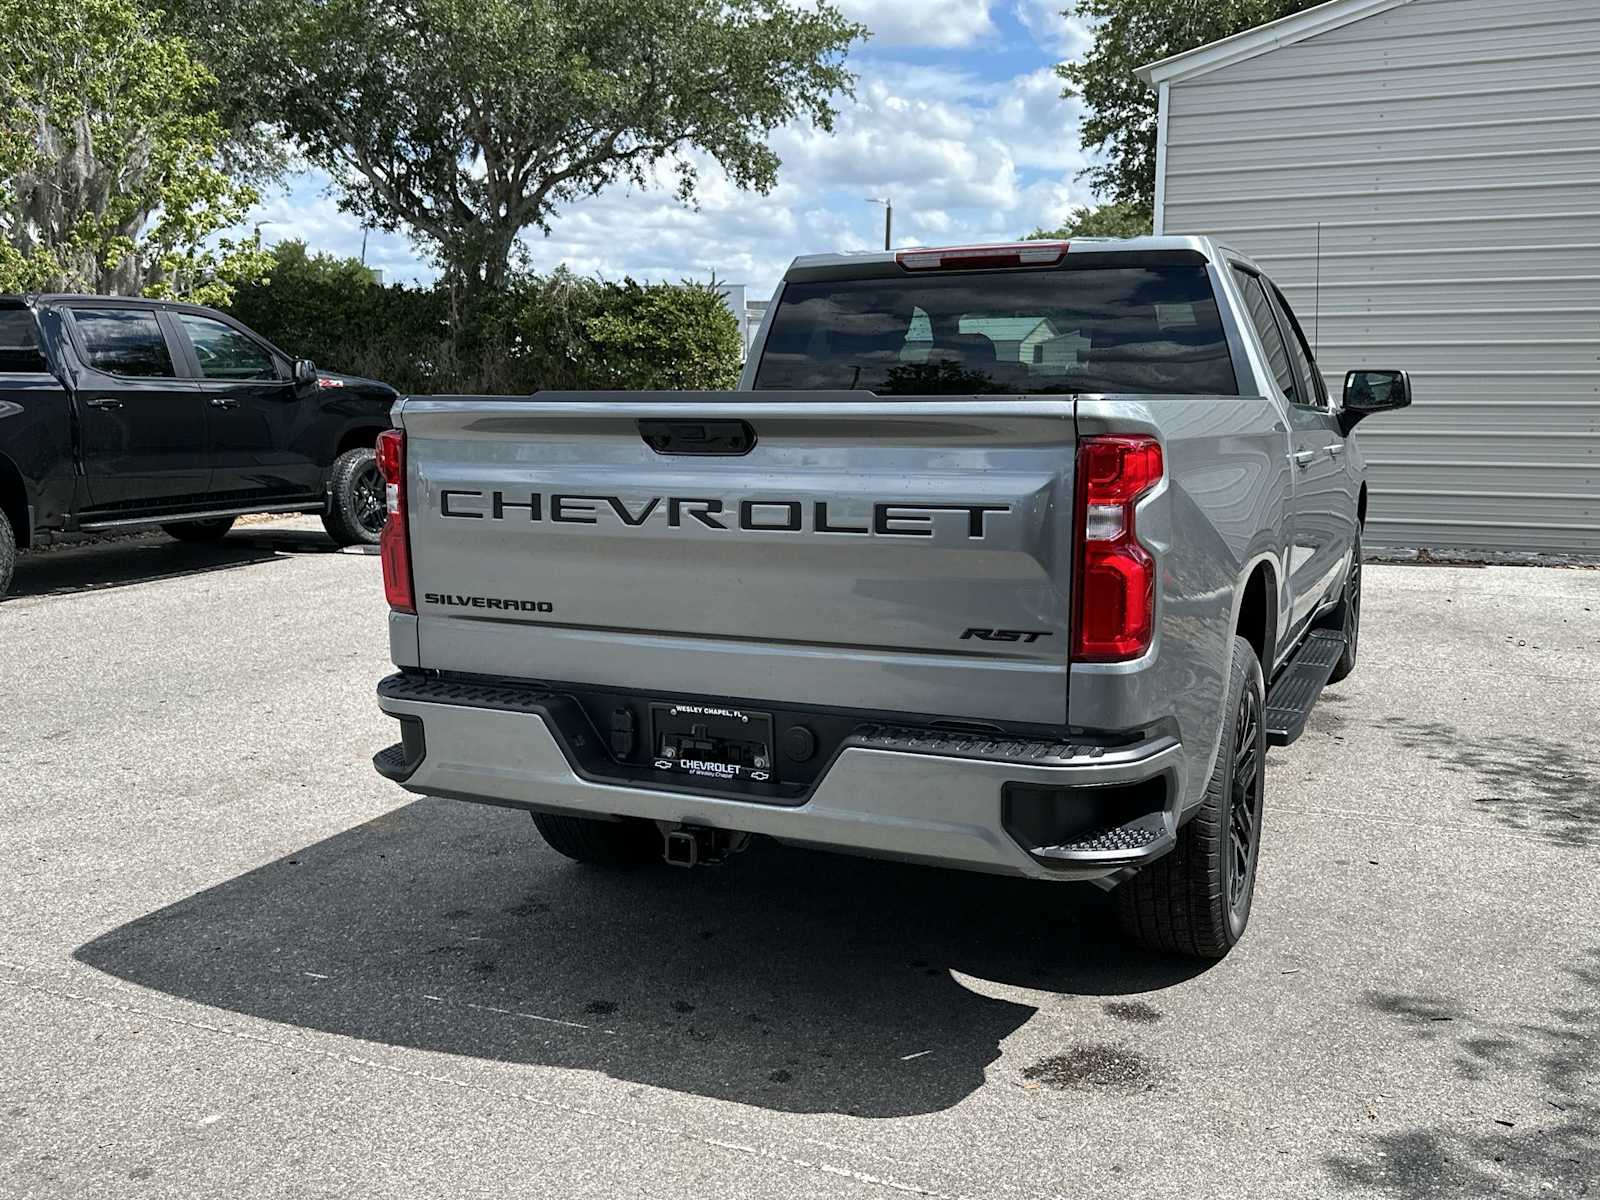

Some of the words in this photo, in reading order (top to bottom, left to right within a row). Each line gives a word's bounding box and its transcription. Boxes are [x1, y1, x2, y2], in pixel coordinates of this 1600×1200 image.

[440, 490, 1010, 539] CHEVROLET
[425, 593, 553, 613] SILVERADO
[959, 628, 1053, 643] RST
[675, 705, 703, 713] WESLEY
[703, 708, 733, 717] CHAPEL,
[680, 759, 741, 774] CHEVROLET
